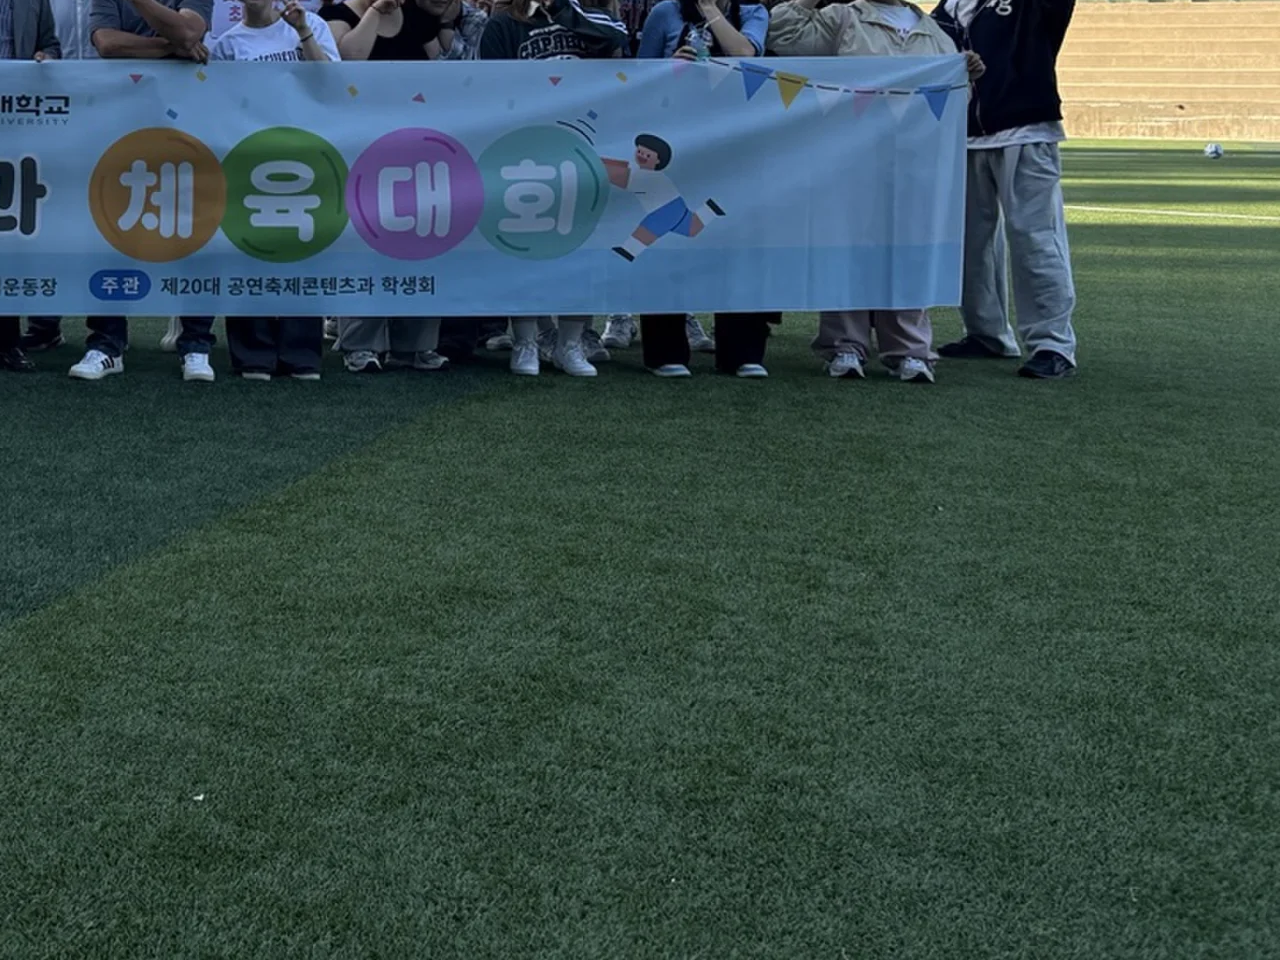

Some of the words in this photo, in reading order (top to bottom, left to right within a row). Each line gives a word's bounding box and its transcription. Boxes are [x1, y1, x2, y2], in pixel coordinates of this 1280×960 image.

[100, 277, 141, 295] 주관
[160, 277, 220, 296] 제20대
[227, 276, 374, 296] 공연축제콘텐츠과
[381, 276, 436, 296] 학생회
